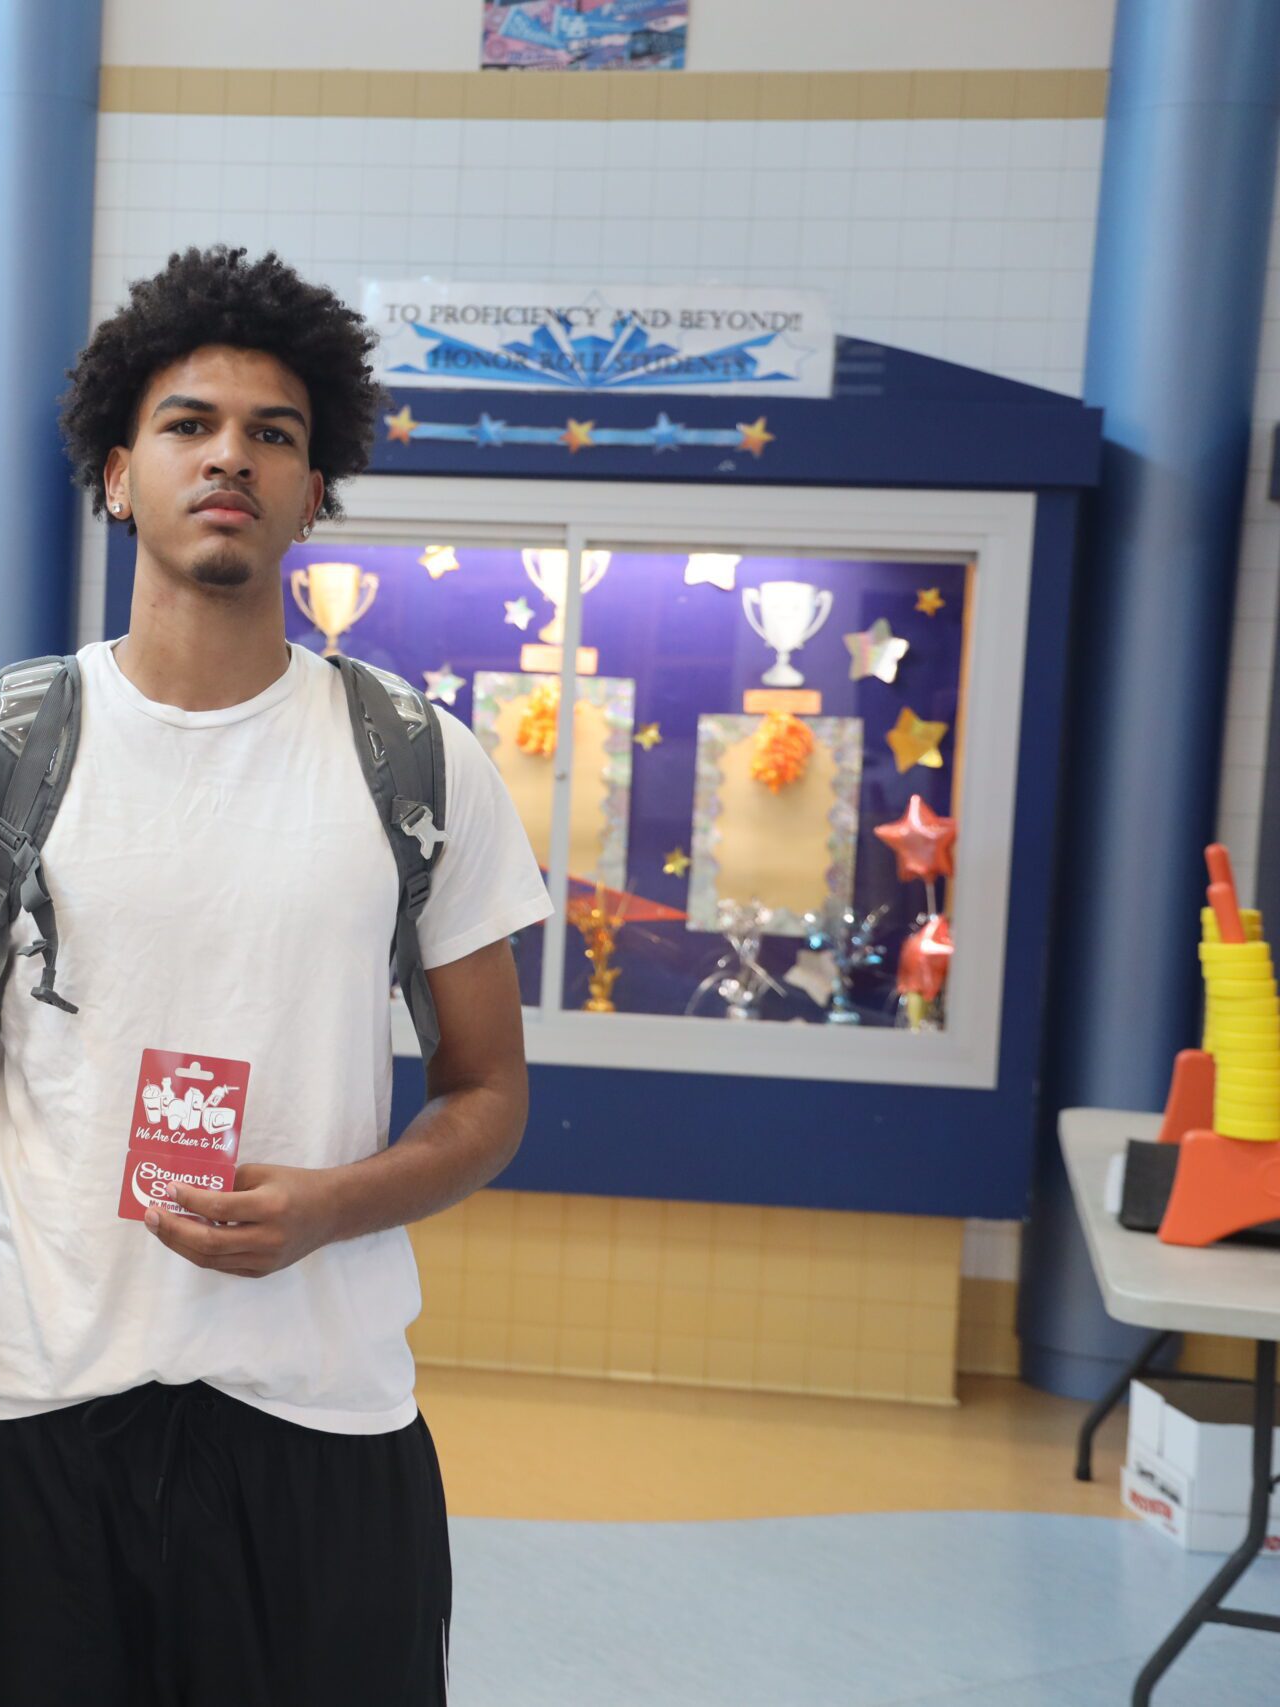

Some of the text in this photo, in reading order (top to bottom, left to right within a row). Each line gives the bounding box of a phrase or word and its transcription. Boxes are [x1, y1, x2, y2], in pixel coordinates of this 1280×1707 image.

[386, 303, 421, 324] TO
[429, 303, 600, 328] PROFICIENCY
[612, 307, 671, 329] AND
[431, 348, 529, 371] HONOR
[135, 1126, 151, 1140] We
[151, 1129, 170, 1143] Are
[170, 1131, 199, 1147] Closer
[200, 1137, 210, 1149] to
